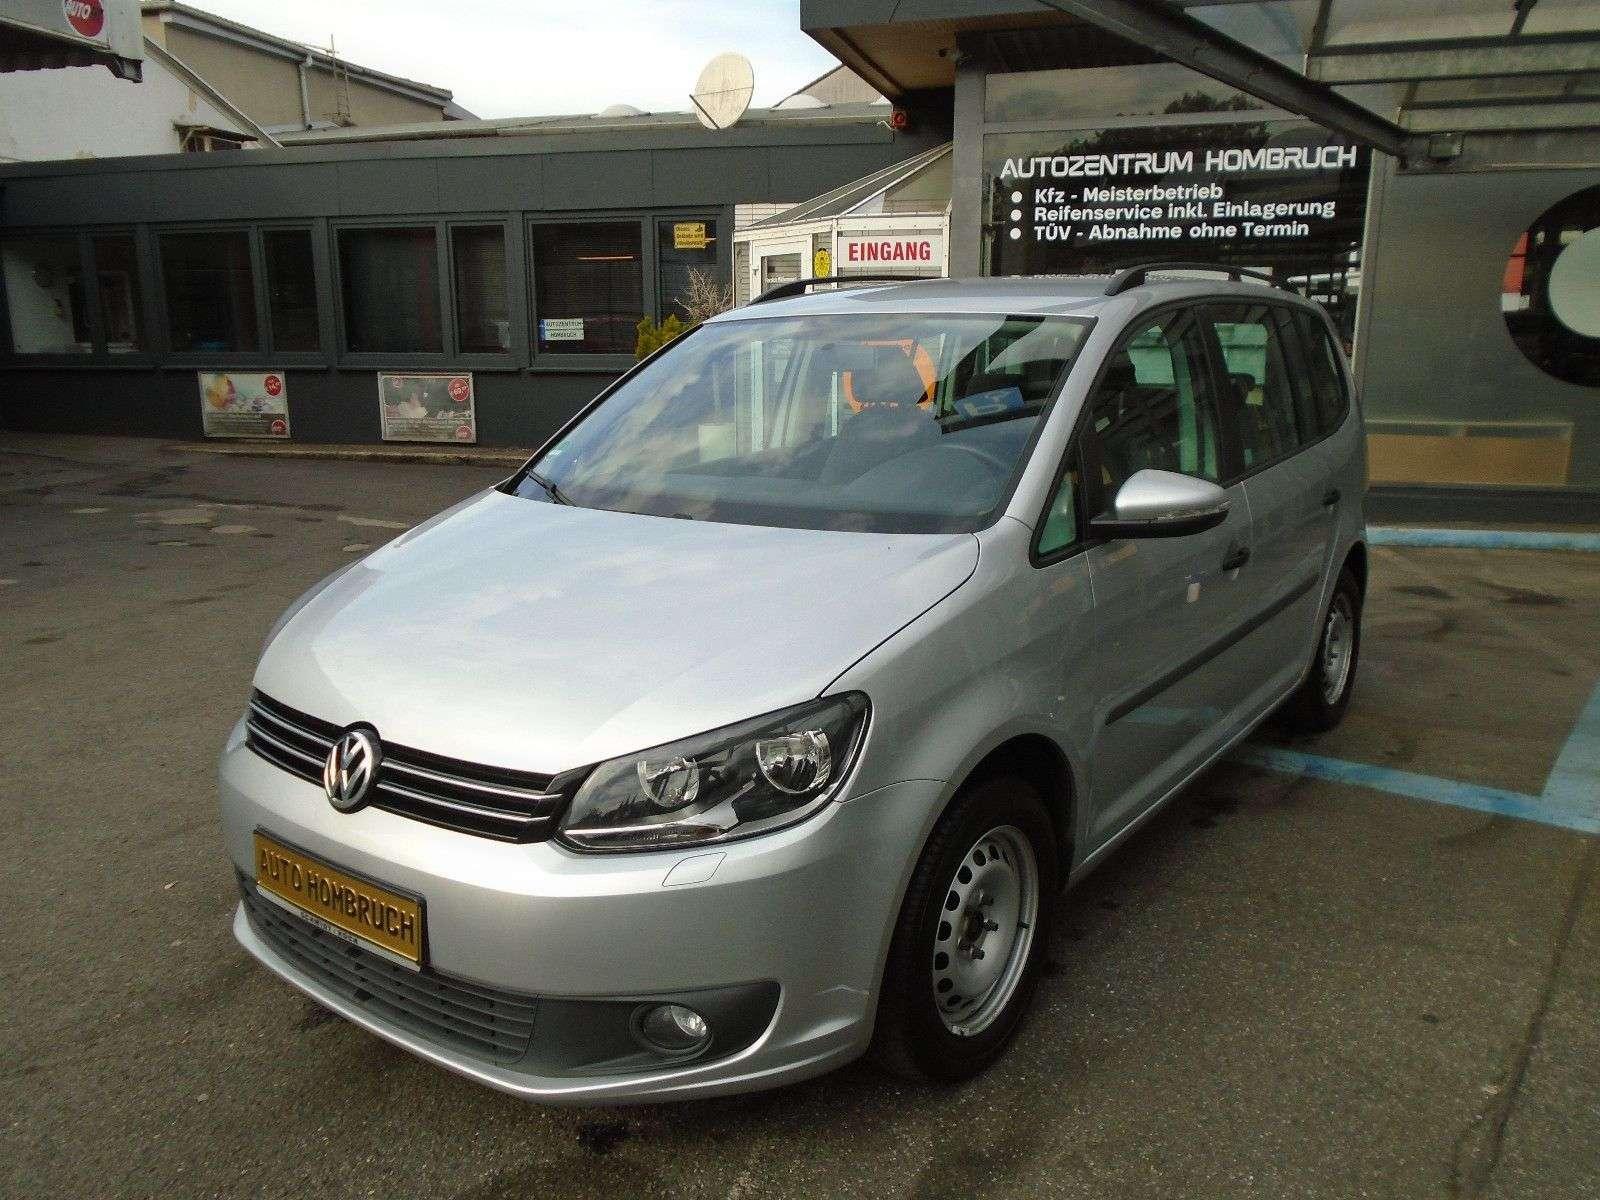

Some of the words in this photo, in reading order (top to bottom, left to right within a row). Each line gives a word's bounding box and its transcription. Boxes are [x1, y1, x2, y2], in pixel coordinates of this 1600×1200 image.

[1000, 152, 1194, 178] AUTOZENTRUM
[1205, 145, 1357, 172] HOMBRUCH
[1034, 188, 1065, 203] Kfz
[1083, 183, 1223, 202] Meisterbetrieb
[1034, 205, 1163, 222] Reifenservice
[1168, 201, 1208, 219] inkl.
[1213, 200, 1336, 219] Einlagerung
[1033, 223, 1071, 241] TÜV
[1088, 223, 1182, 240] Abnahme
[1189, 222, 1237, 238] ohne
[1243, 220, 1309, 237] Termin
[848, 242, 931, 262] EINGANG
[261, 847, 302, 890] AUTO
[307, 868, 415, 945] HOMBRUCH
